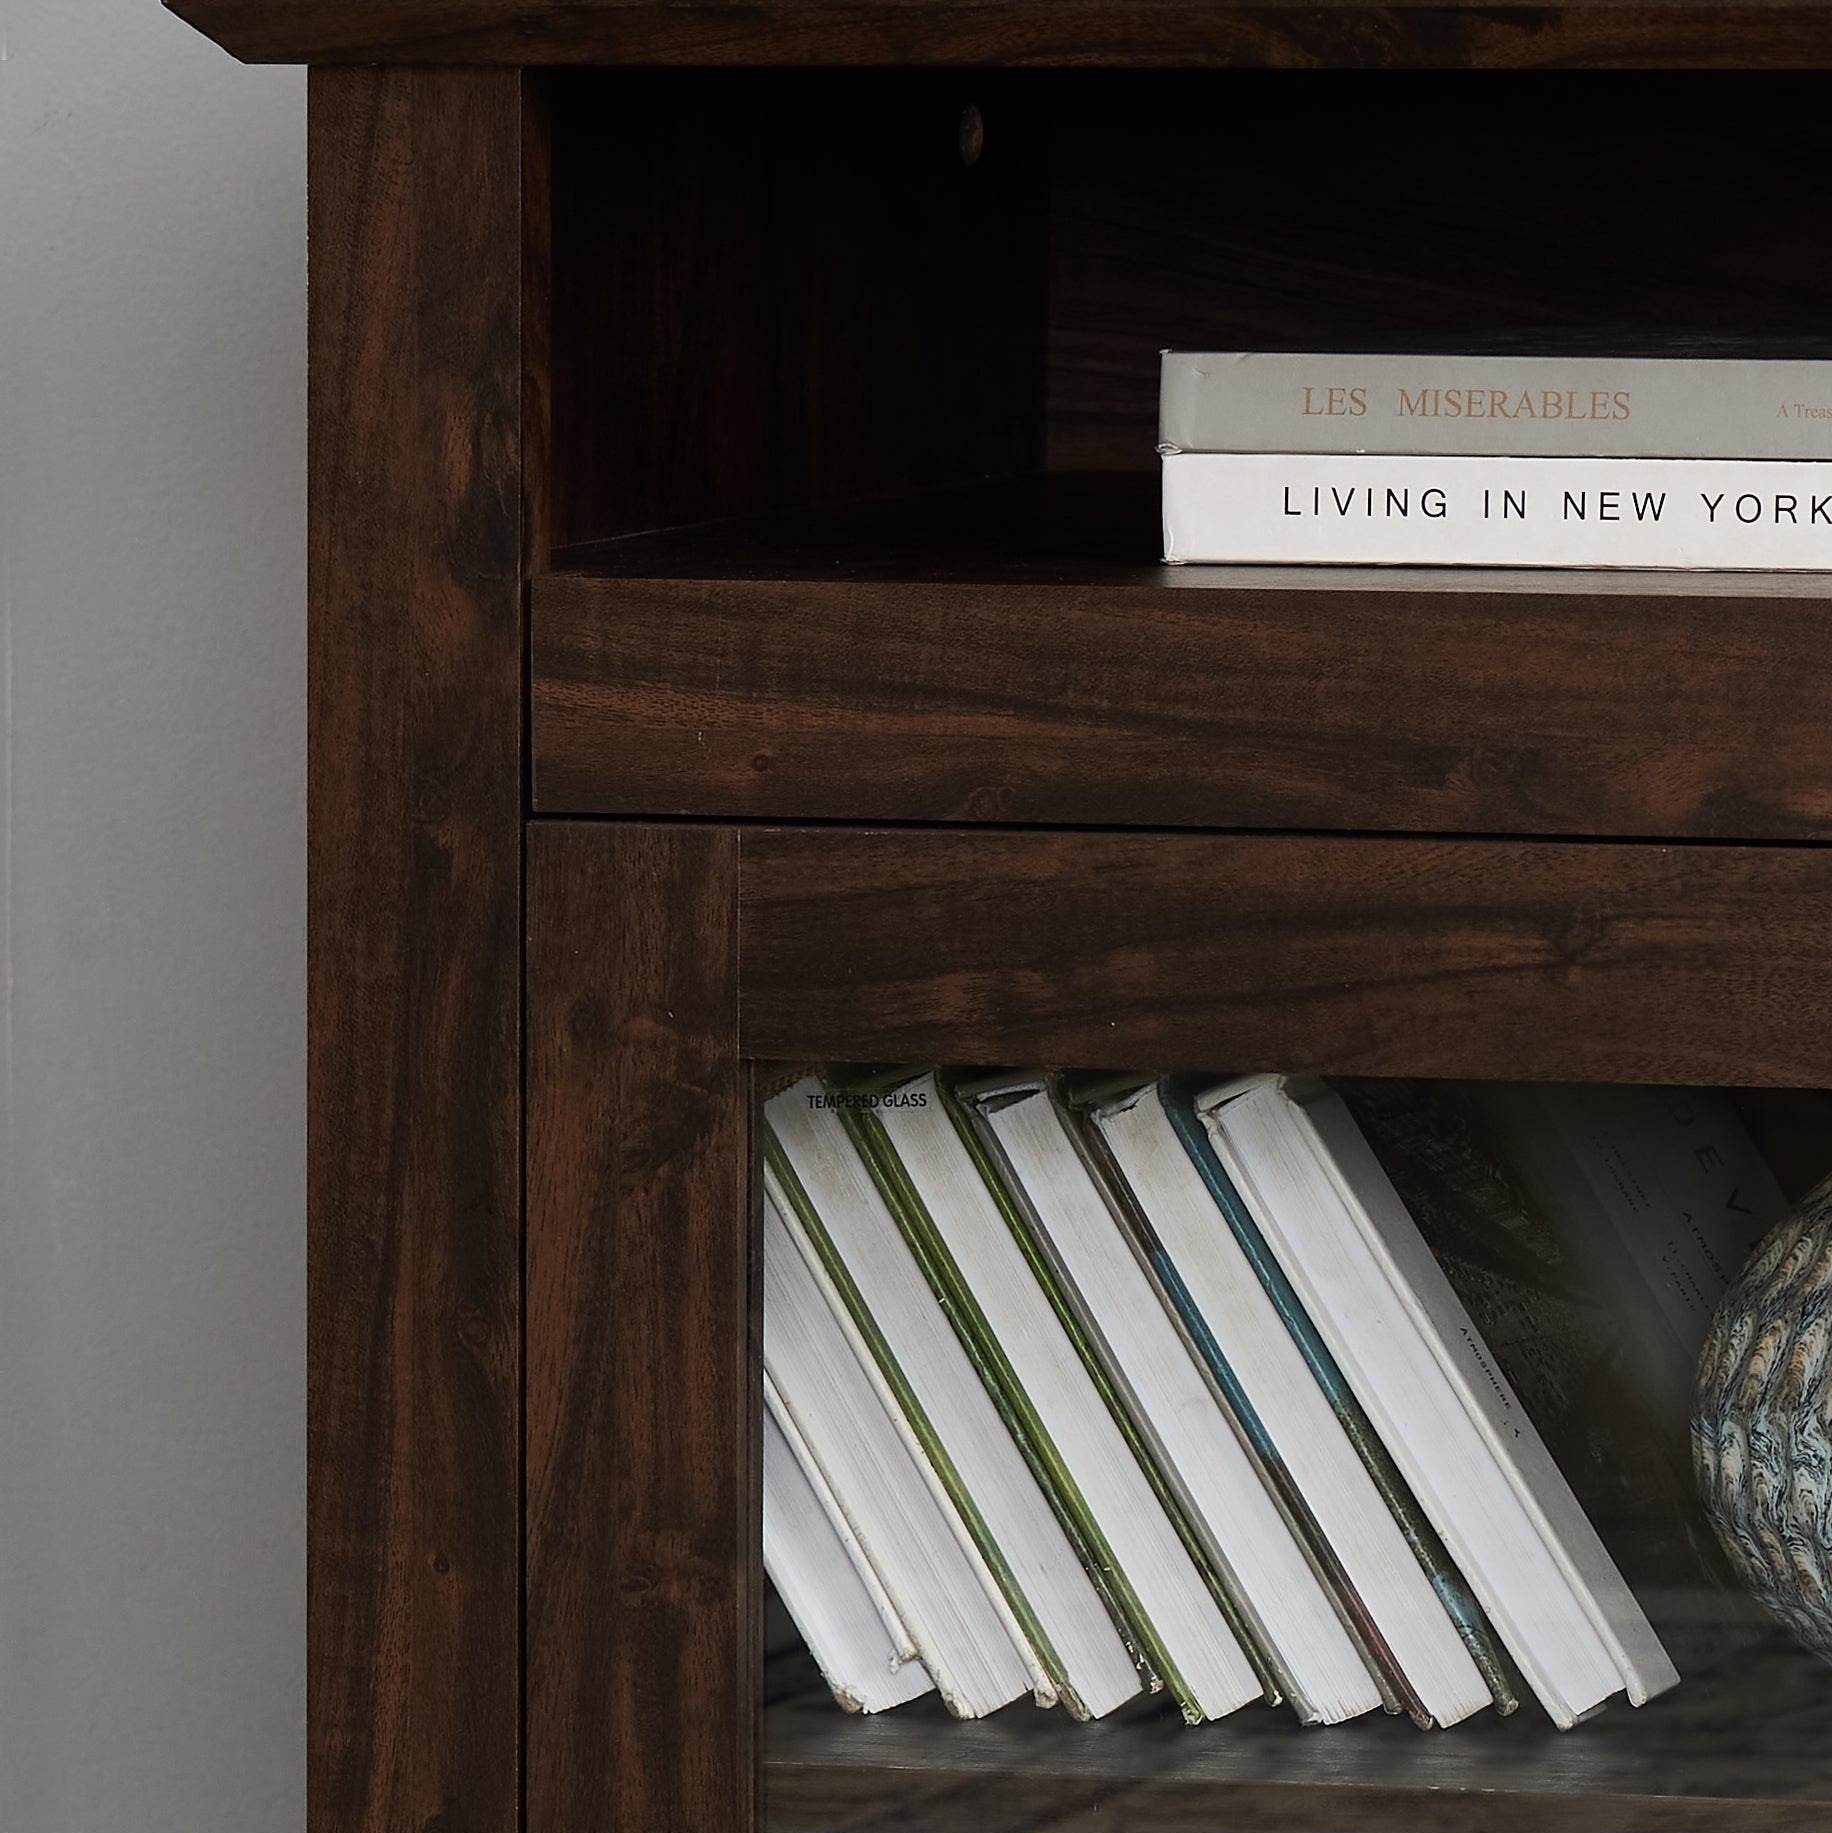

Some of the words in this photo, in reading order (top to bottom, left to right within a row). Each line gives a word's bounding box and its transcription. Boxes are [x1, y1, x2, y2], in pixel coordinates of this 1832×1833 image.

[1302, 386, 1367, 417] LES
[1398, 388, 1631, 421] MISERABLES
[1776, 404, 1789, 418] A
[1284, 486, 1447, 518] LIVING
[1484, 489, 1526, 519] IN
[1563, 491, 1667, 522] NEW
[807, 1095, 879, 1109] TEMPERED
[883, 1093, 927, 1108] GLASS
